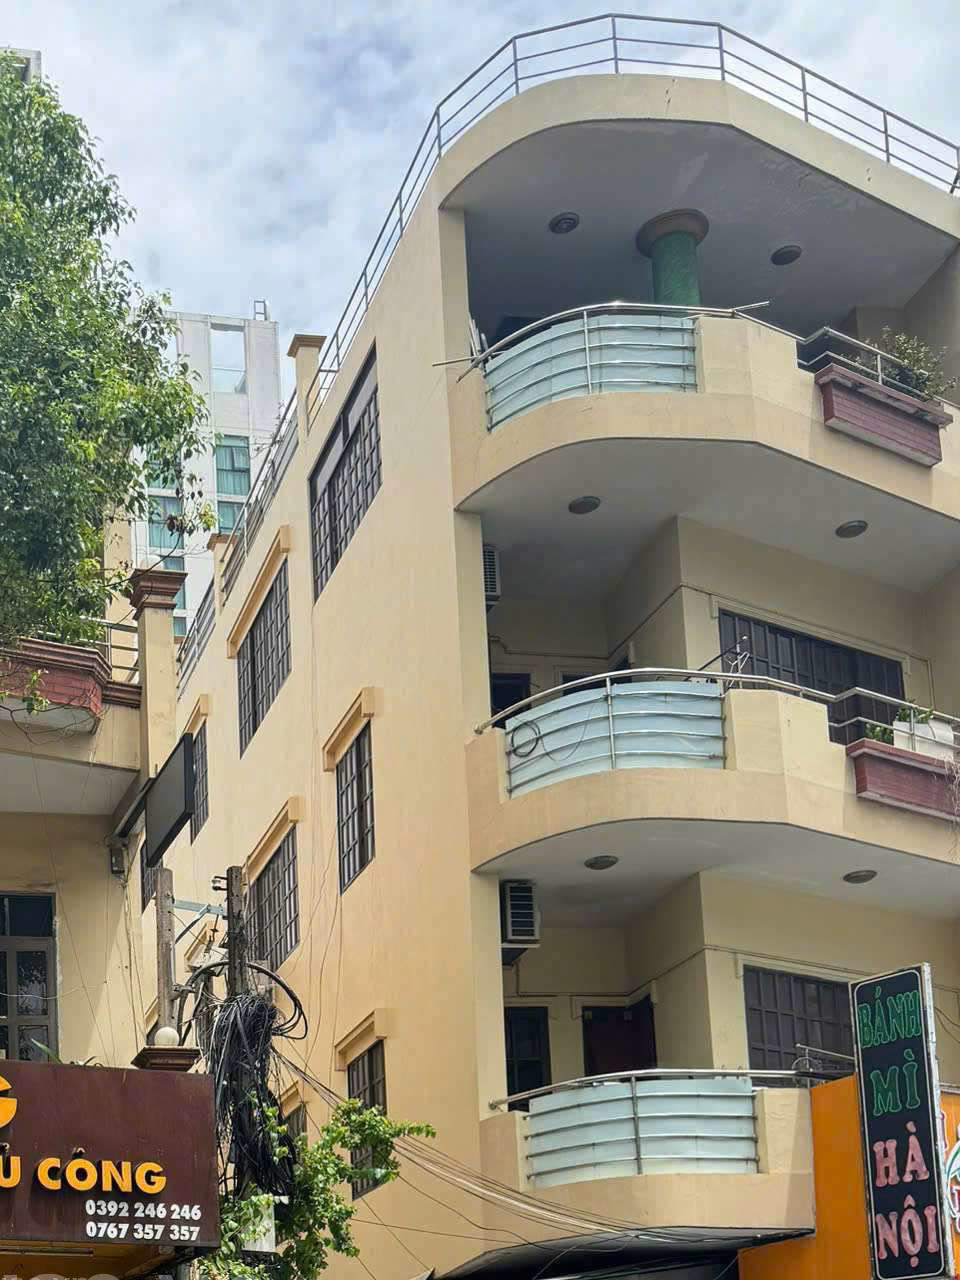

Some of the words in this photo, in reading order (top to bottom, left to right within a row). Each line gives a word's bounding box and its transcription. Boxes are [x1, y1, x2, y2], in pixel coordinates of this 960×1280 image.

[858, 985, 922, 1049] BÁNH
[870, 1048, 921, 1117] MÌ
[37, 1147, 168, 1195] CÔNG
[872, 1120, 930, 1188] HÀ
[85, 1200, 129, 1218] 0392
[134, 1202, 166, 1219] 246
[168, 1204, 201, 1222] 246
[85, 1221, 130, 1240] 0767
[133, 1223, 165, 1241] 357
[169, 1224, 200, 1242] 357
[874, 1193, 940, 1269] NỘI
